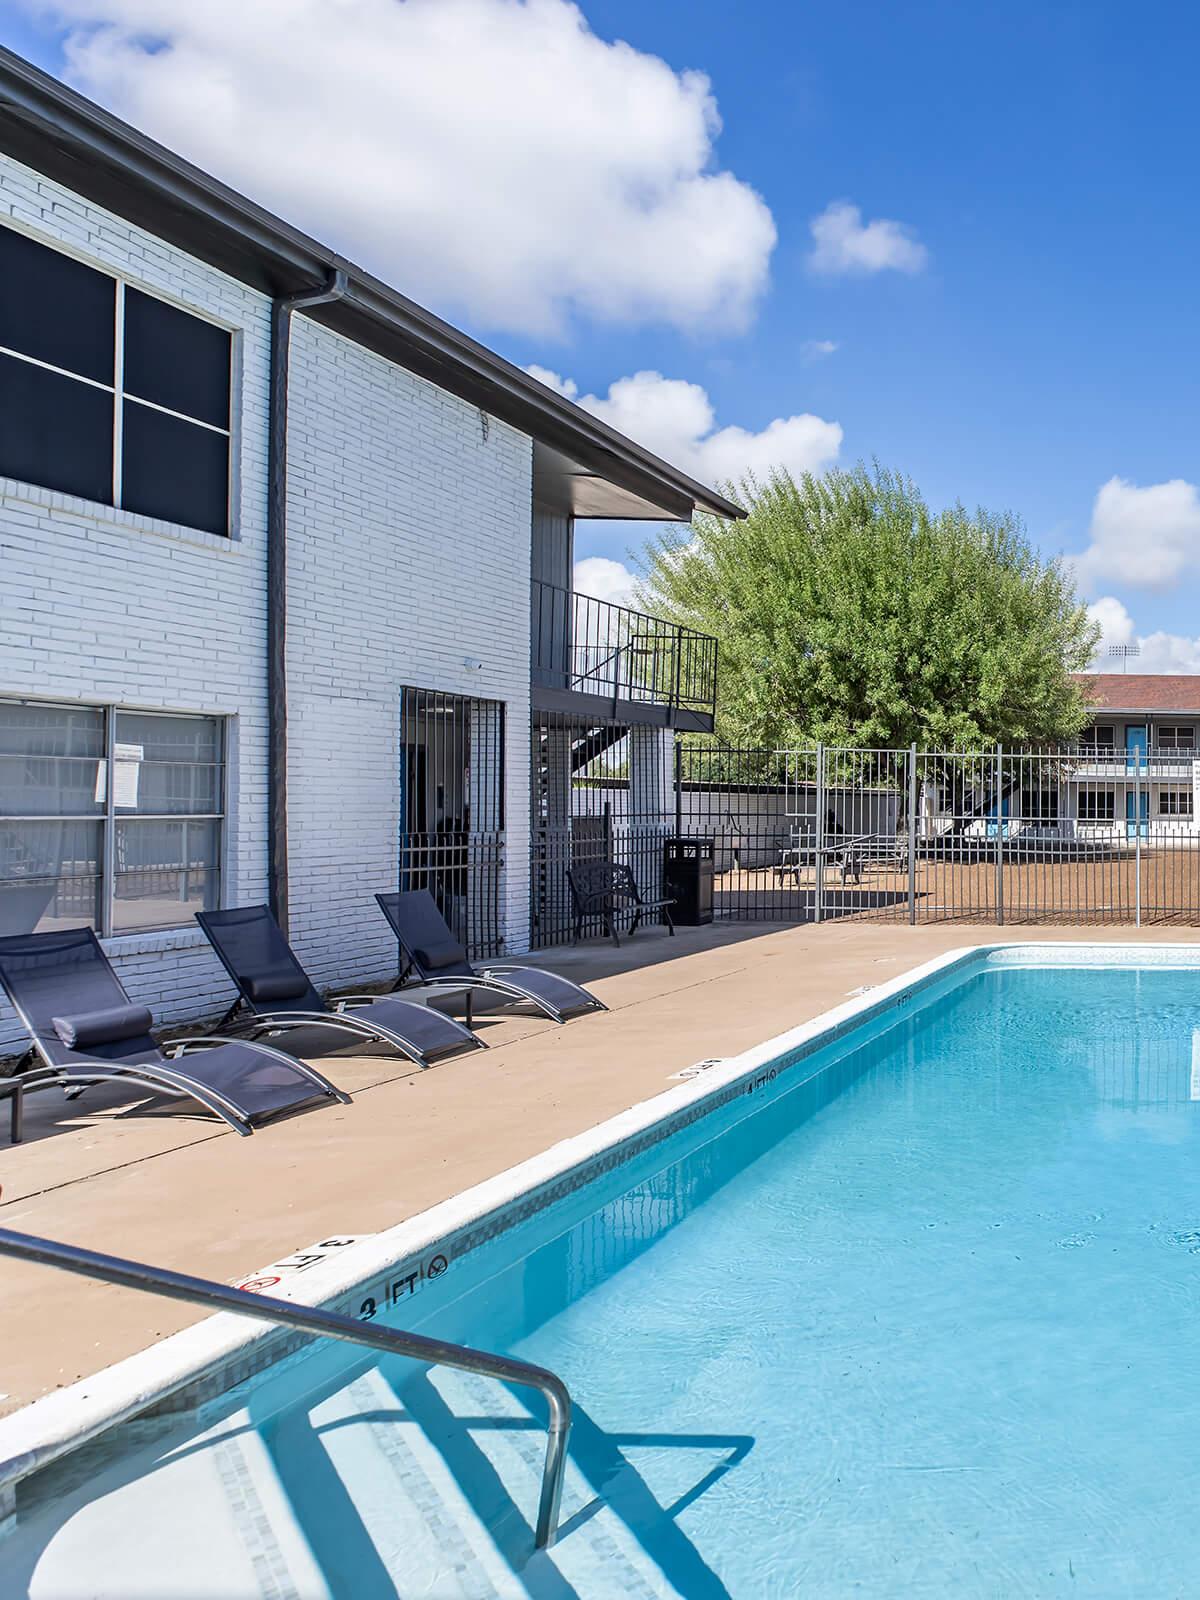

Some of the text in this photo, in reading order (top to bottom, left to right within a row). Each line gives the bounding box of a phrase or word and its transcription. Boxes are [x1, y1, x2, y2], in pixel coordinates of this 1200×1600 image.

[274, 1239, 355, 1270] 3 FT
[359, 1272, 418, 1321] 3 FT
